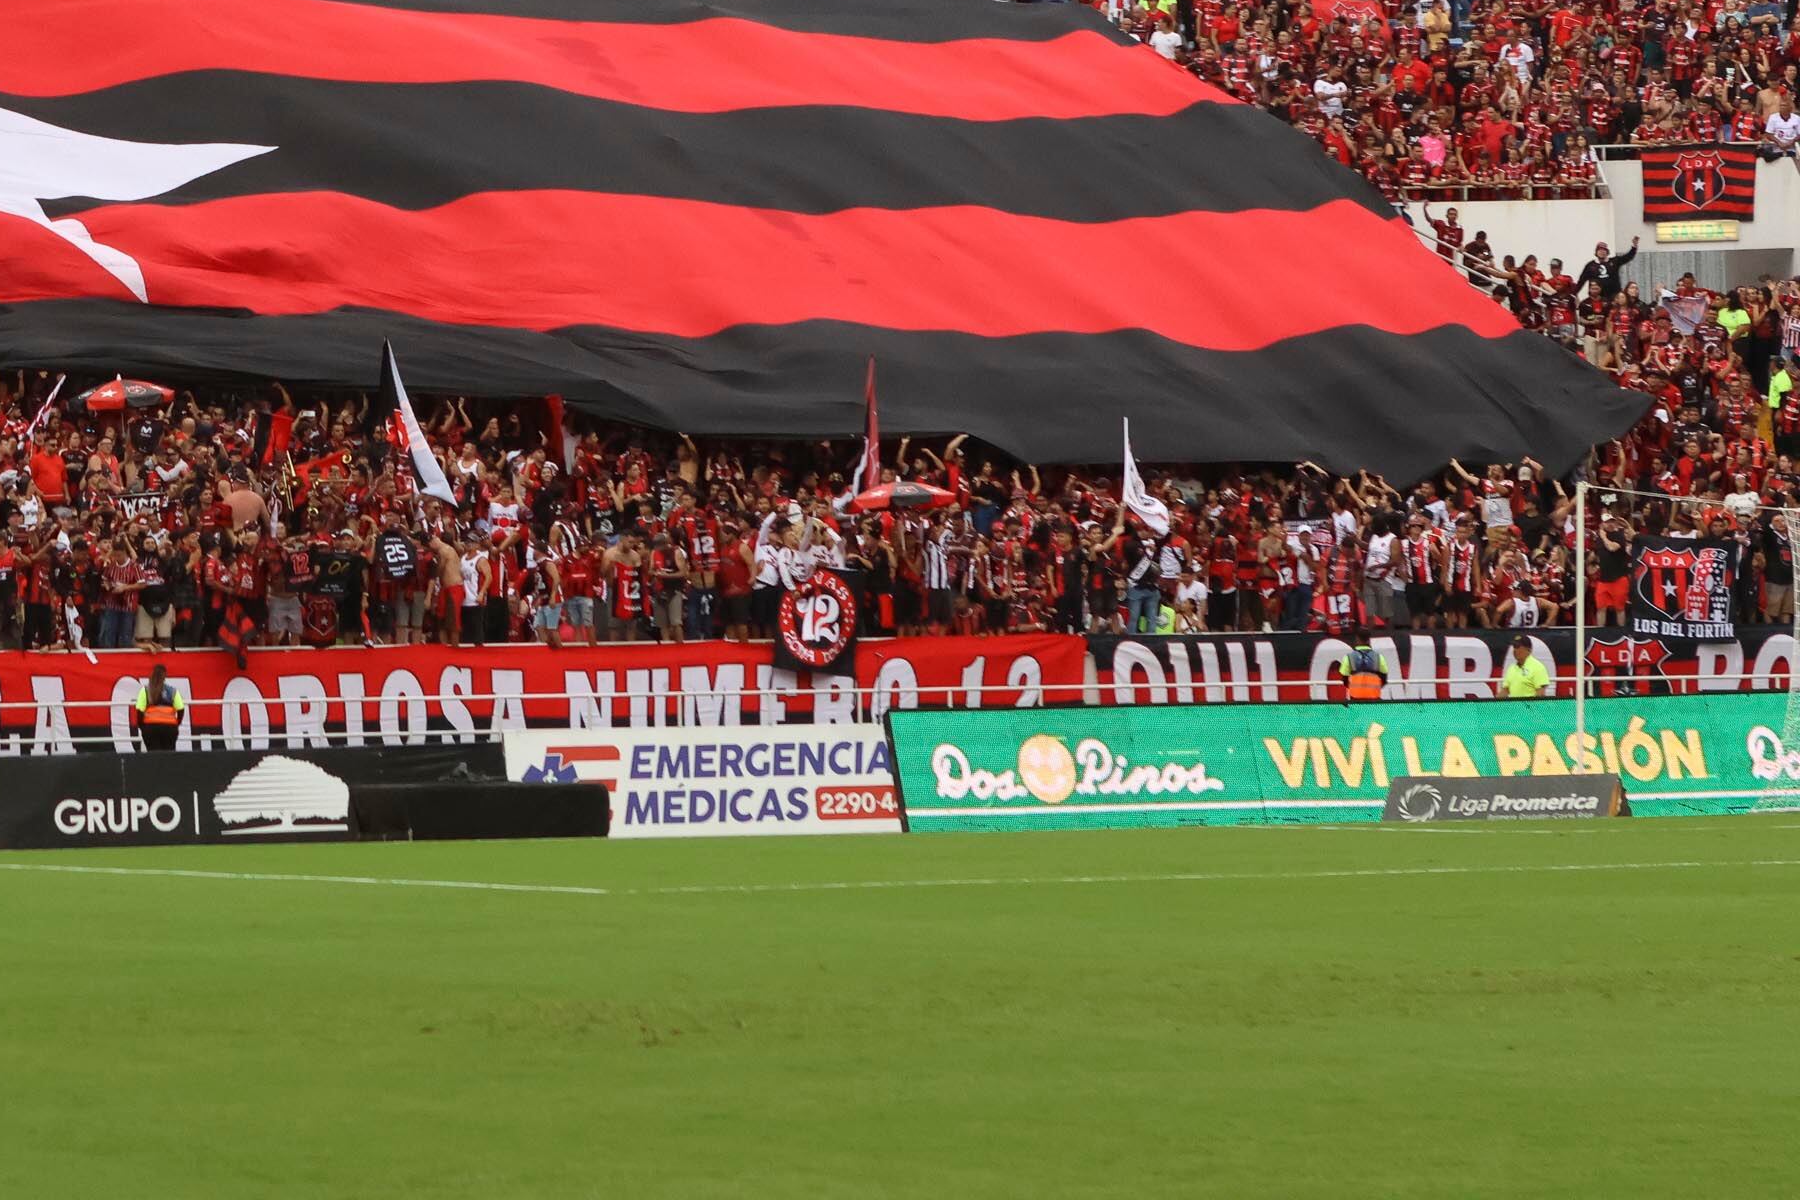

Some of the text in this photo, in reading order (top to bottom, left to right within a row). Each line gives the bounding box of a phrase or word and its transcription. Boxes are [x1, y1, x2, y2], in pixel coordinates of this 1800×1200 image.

[1685, 160, 1713, 169] LDA
[384, 544, 409, 563] 25
[1649, 556, 1686, 567] LDA
[1328, 594, 1351, 615] 12
[796, 594, 840, 642] 12
[1634, 618, 1734, 638] LOS DEL FORTIN
[1600, 647, 1652, 663] LDA
[630, 741, 892, 779] EMERGENCIA
[1263, 716, 1708, 788] VIVÍ LA PASIÓN
[931, 738, 1225, 800] Dos Pinos
[625, 783, 809, 824] MÉDICAS
[820, 791, 897, 814] 2290-4
[1448, 793, 1599, 816] Liga Promerica
[54, 796, 181, 835] GRUPO
